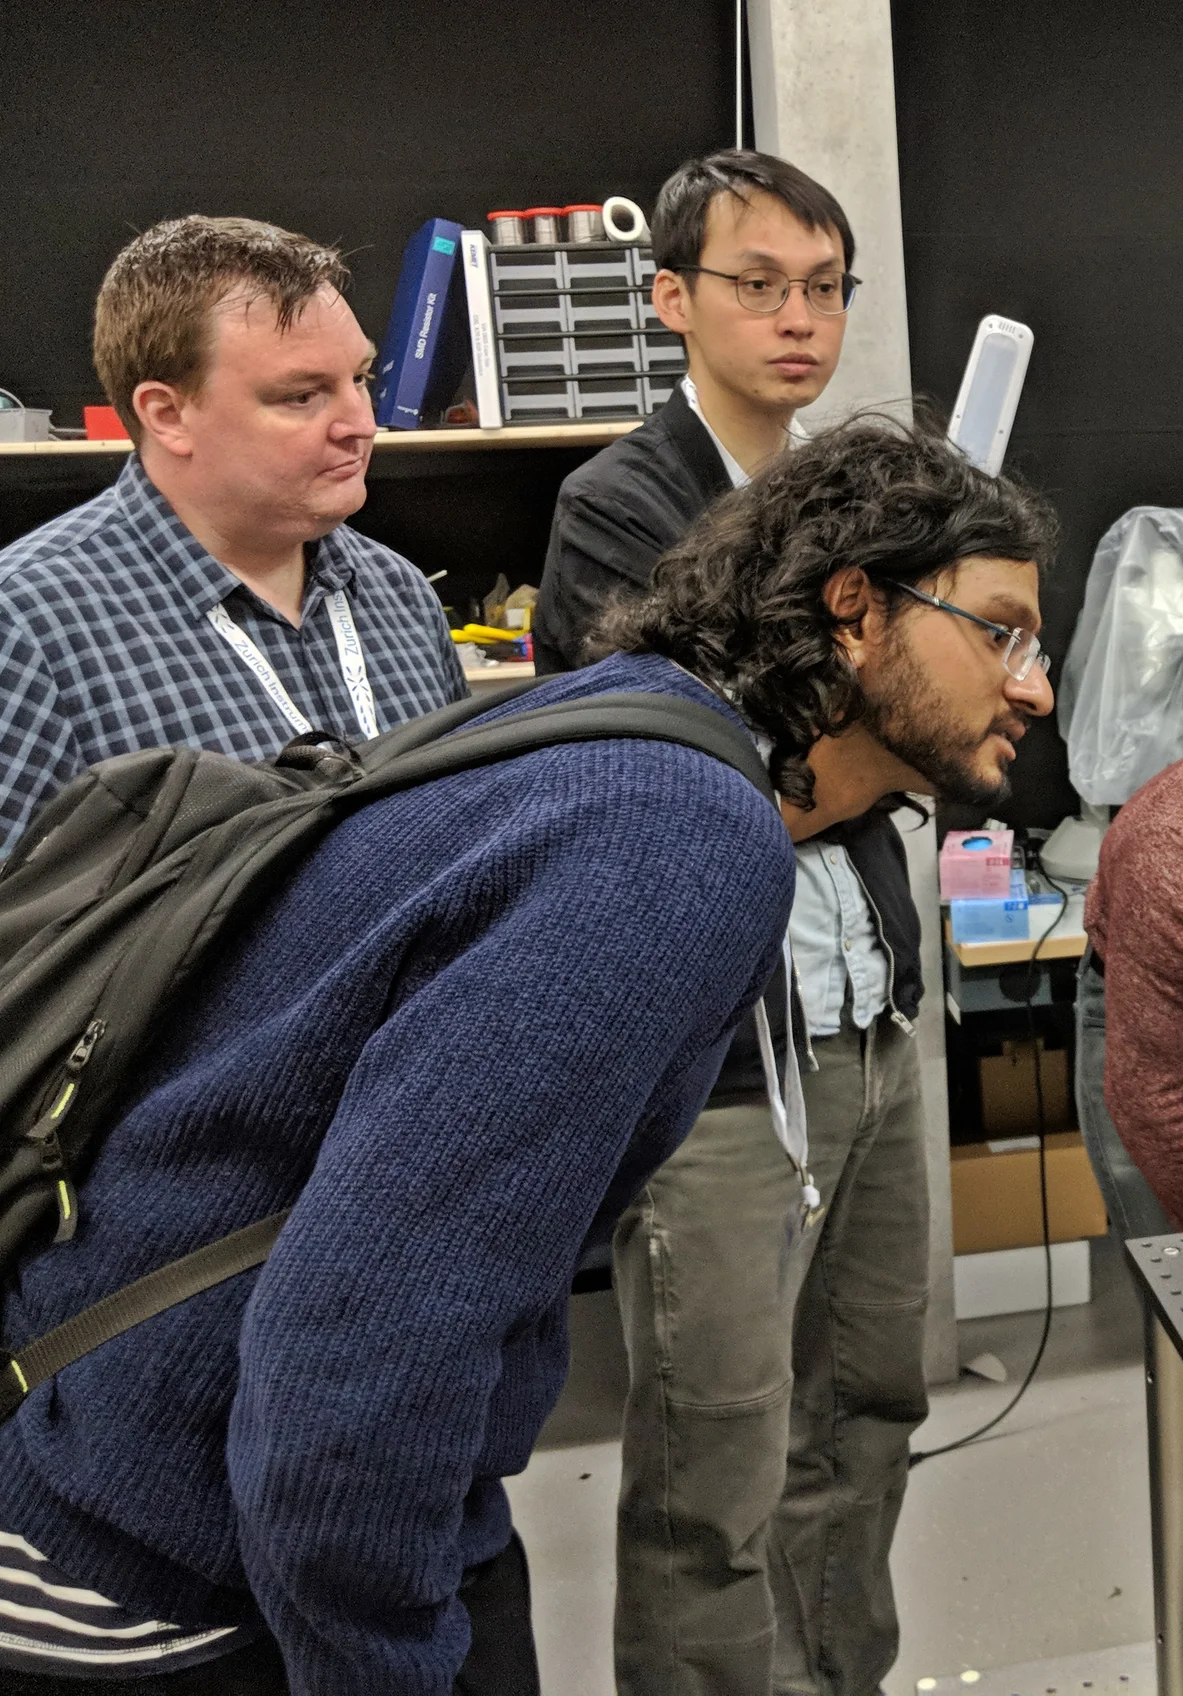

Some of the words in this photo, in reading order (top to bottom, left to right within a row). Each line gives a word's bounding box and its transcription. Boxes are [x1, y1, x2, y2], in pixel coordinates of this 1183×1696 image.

[426, 292, 438, 305] Kit
[419, 305, 434, 338] Resistor
[414, 338, 427, 360] SMD
[337, 615, 359, 656] Zurich
[234, 640, 271, 682] Zurich
